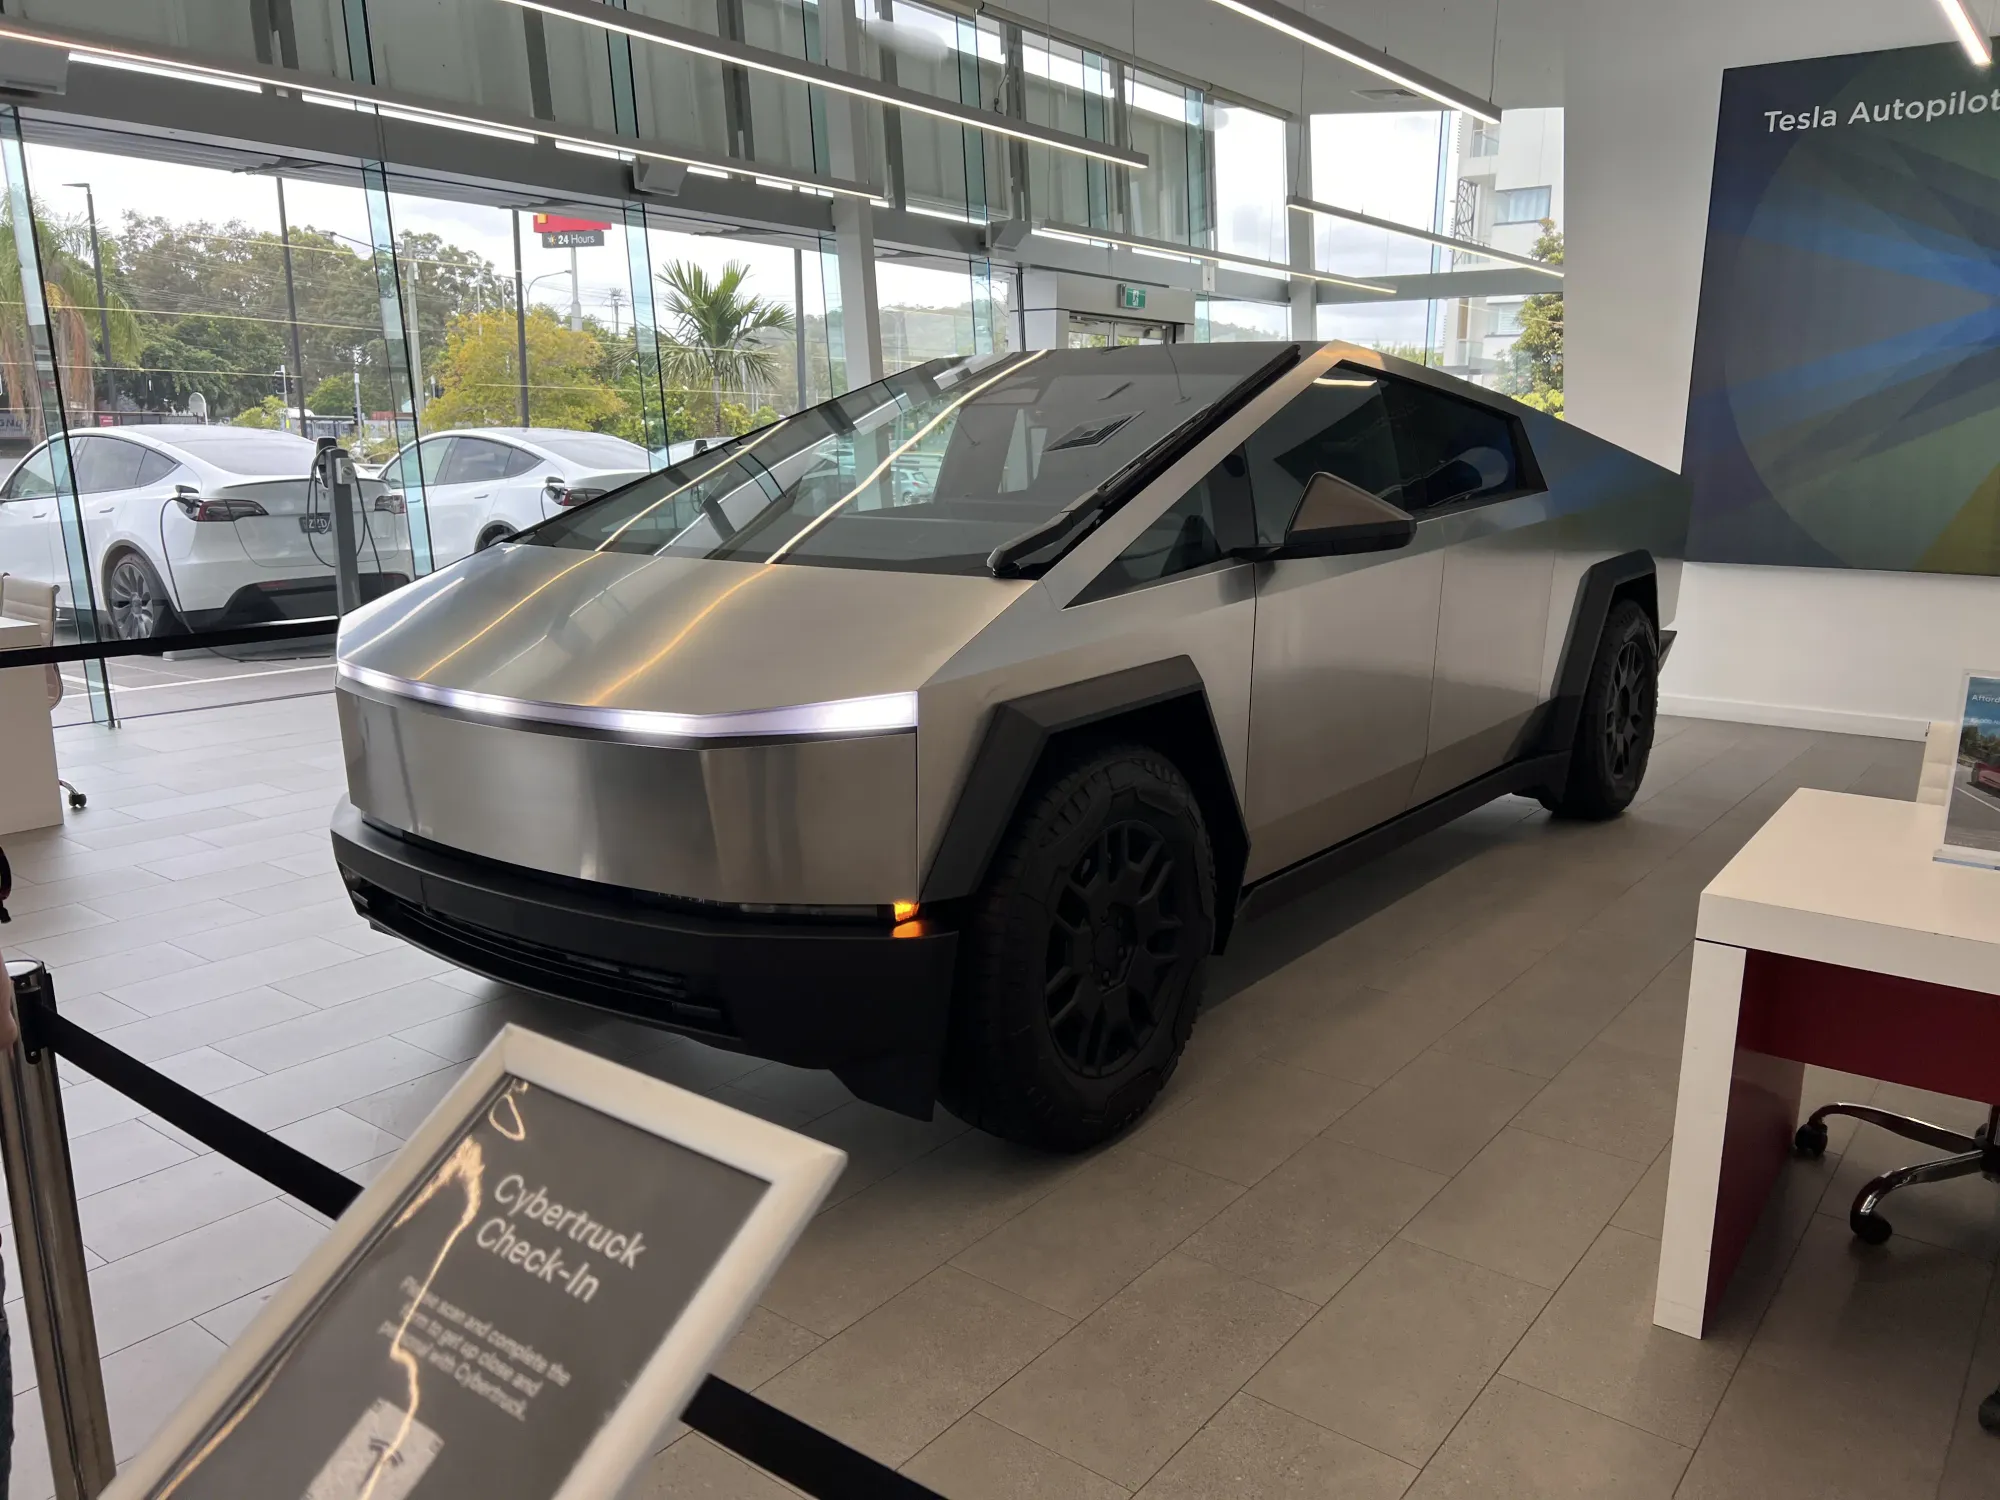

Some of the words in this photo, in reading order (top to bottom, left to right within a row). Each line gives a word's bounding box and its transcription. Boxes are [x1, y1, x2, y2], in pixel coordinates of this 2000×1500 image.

[1764, 106, 1837, 132] Tesla
[1847, 89, 2000, 124] Autopilot
[558, 235, 569, 245] 24
[571, 234, 595, 244] Hours
[475, 1217, 600, 1304] Check-In
[494, 1173, 646, 1270] Cybertruck
[426, 1320, 442, 1339] to
[435, 1328, 465, 1350] get
[459, 1341, 479, 1360] up
[477, 1349, 514, 1382] close
[511, 1371, 543, 1398] and
[427, 1349, 457, 1375] with
[436, 1300, 466, 1325] scan
[464, 1315, 494, 1338] and
[486, 1328, 548, 1374] complete
[546, 1362, 571, 1387] the
